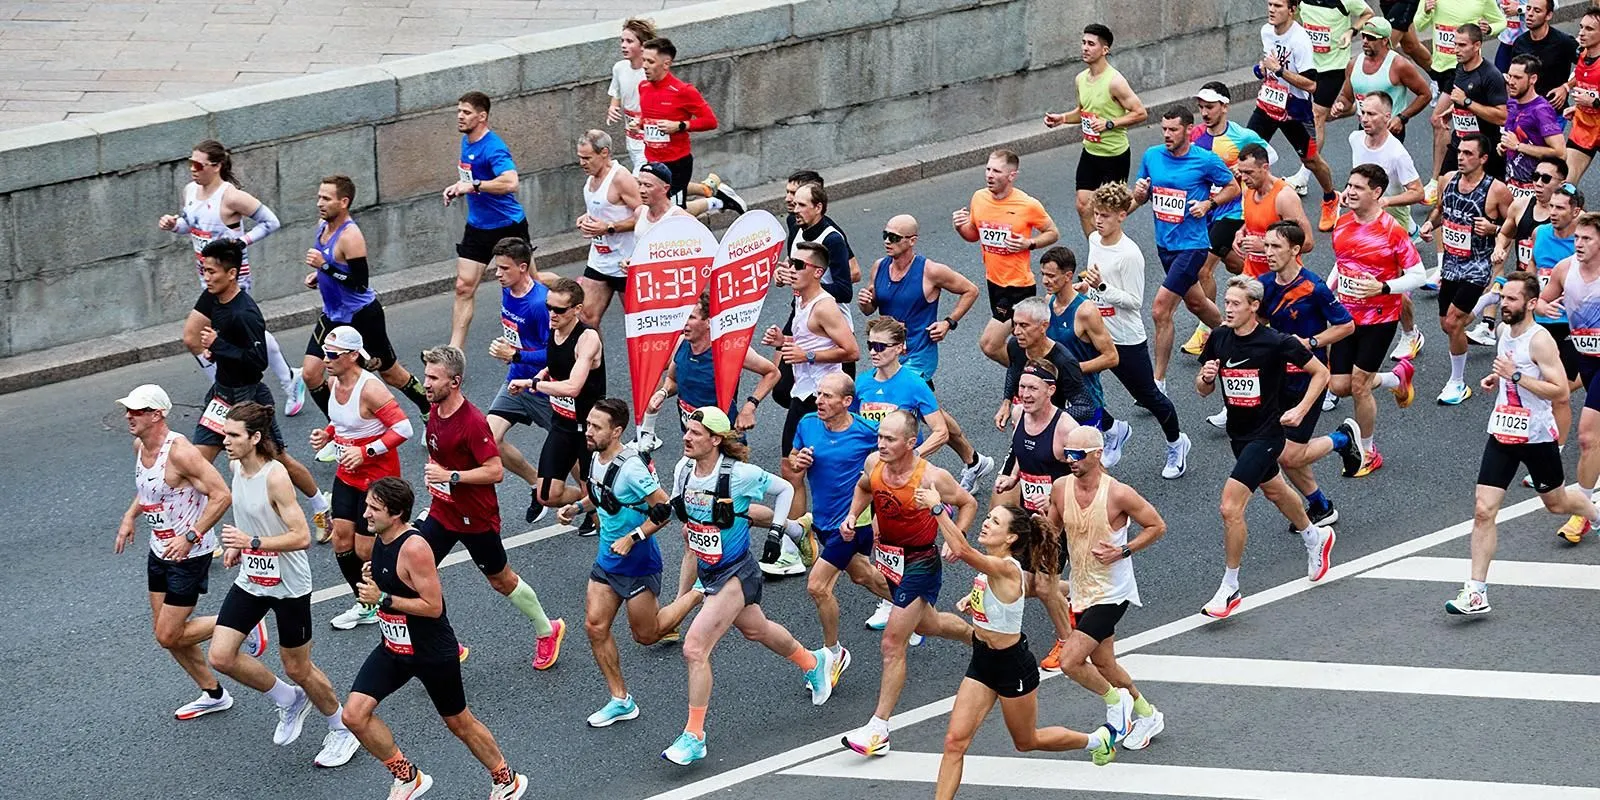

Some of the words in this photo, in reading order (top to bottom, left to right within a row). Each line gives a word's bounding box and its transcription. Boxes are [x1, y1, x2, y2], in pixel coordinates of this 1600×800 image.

[1264, 88, 1284, 102] 9718
[1154, 195, 1184, 209] 11400
[728, 230, 771, 251] МАРАФОН
[983, 229, 1007, 241] 2977
[648, 238, 701, 251] МАРАФОН
[729, 239, 765, 260] МОСКВА
[649, 247, 693, 259] МОСКВА
[636, 266, 697, 303] 0:39
[717, 257, 771, 303] 0:39
[637, 316, 659, 331] 3:54
[1226, 378, 1254, 391] 8299
[1495, 414, 1527, 430] 11025
[687, 530, 719, 548] 25589
[247, 556, 275, 570] 2904
